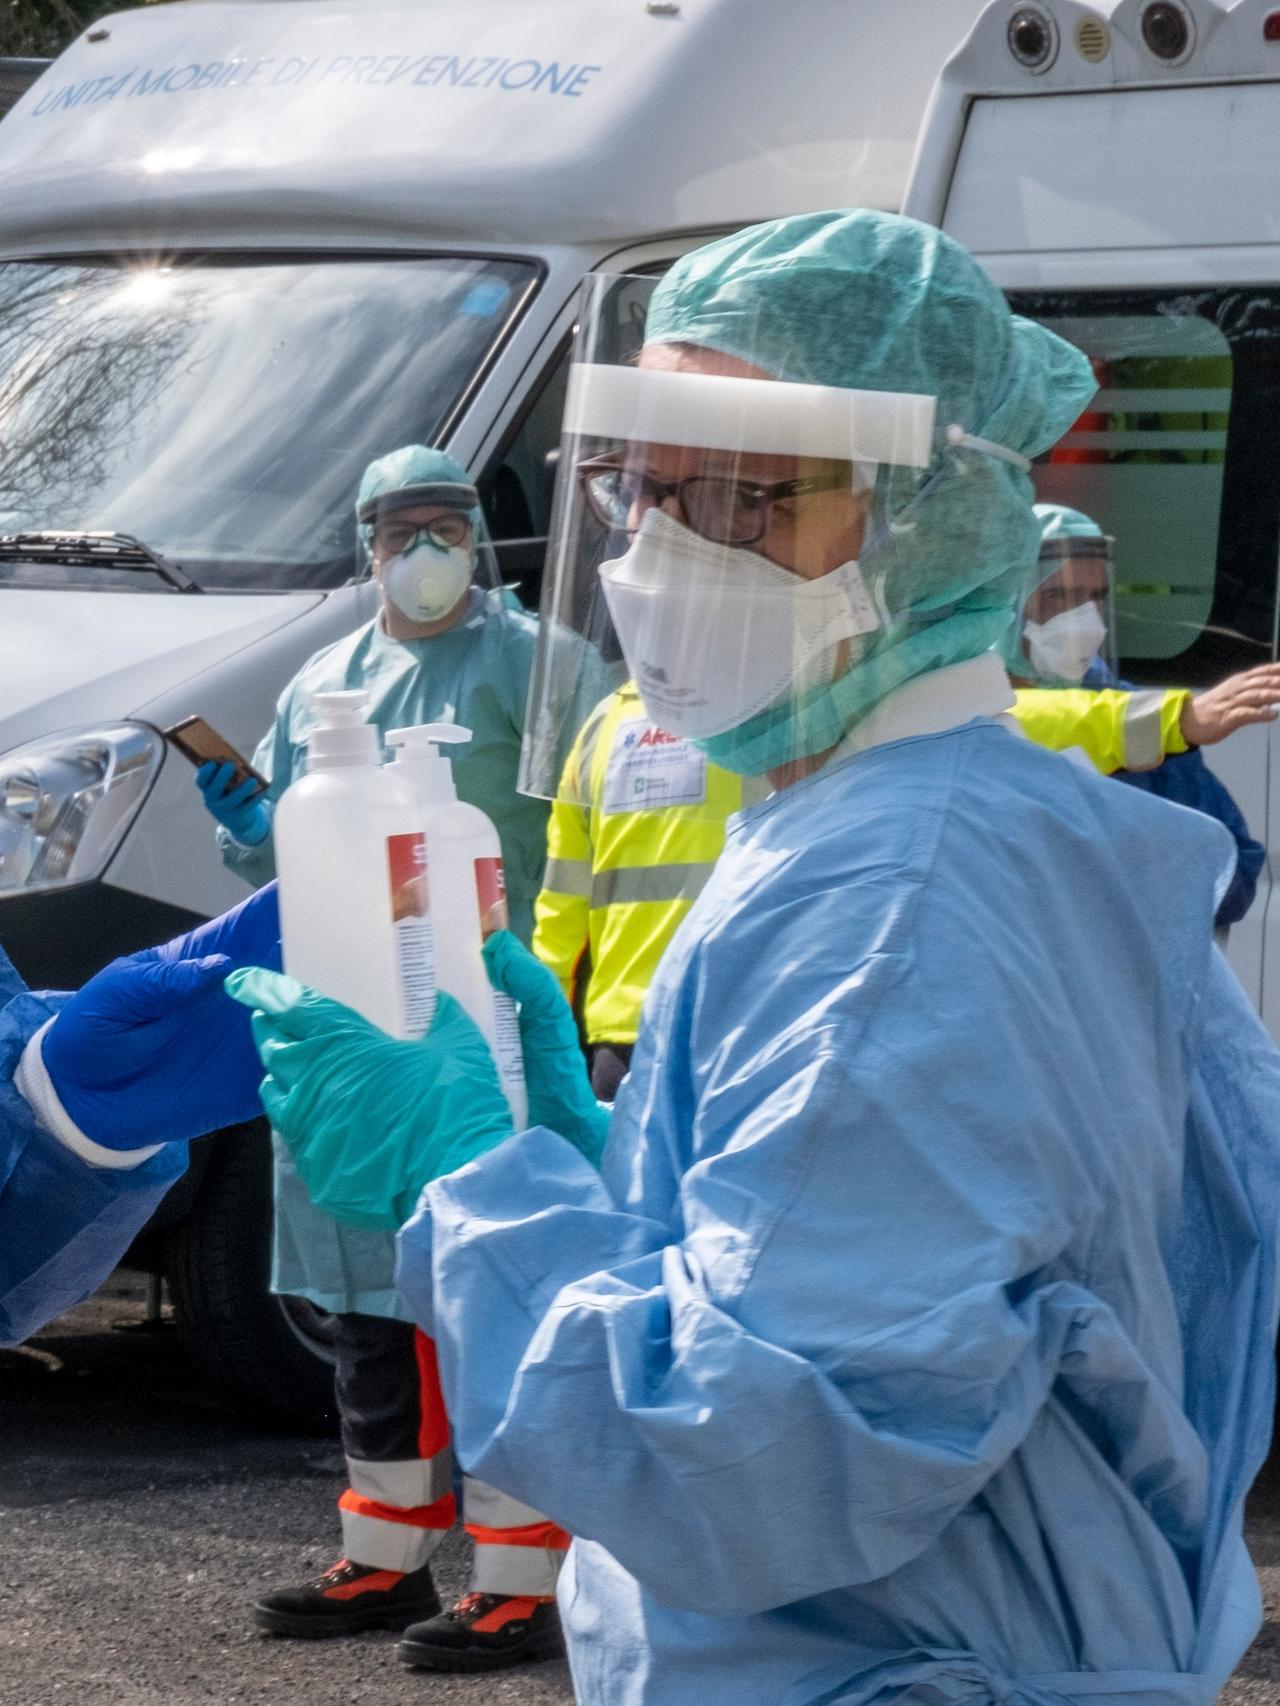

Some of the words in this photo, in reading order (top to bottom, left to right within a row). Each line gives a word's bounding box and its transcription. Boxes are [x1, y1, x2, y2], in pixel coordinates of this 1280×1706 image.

[128, 57, 274, 97] MOBILE
[271, 56, 320, 86] DI
[314, 55, 603, 97] PREVENZIONE
